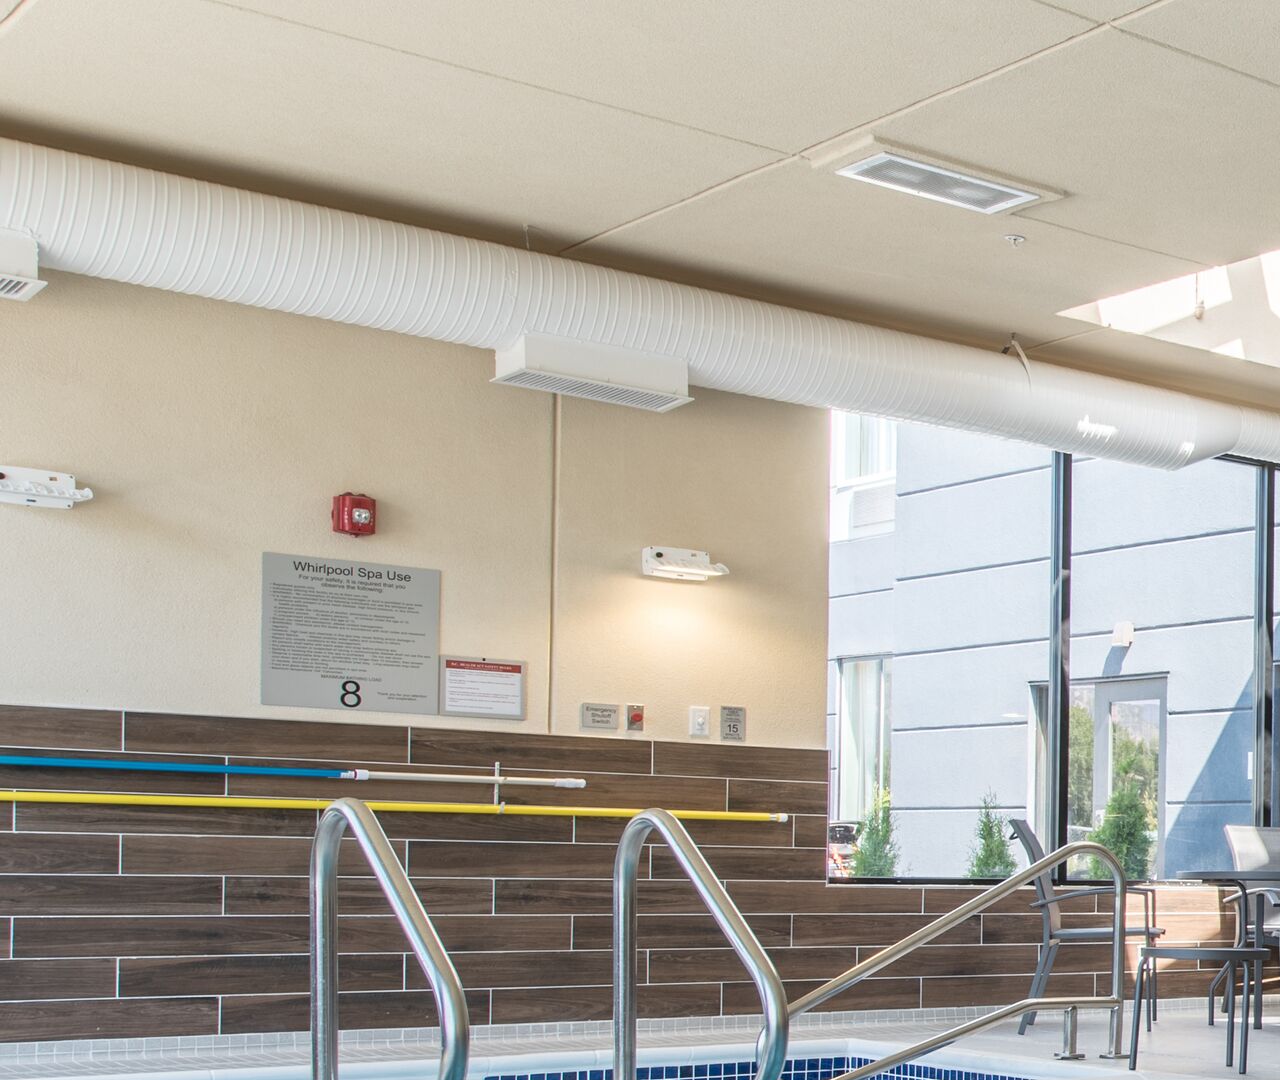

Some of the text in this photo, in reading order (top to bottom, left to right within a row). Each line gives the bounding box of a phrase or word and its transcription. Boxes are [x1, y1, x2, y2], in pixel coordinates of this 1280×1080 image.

[293, 560, 412, 582] Whirlpool Spa Use
[340, 680, 362, 708] 8
[727, 724, 738, 733] 15
